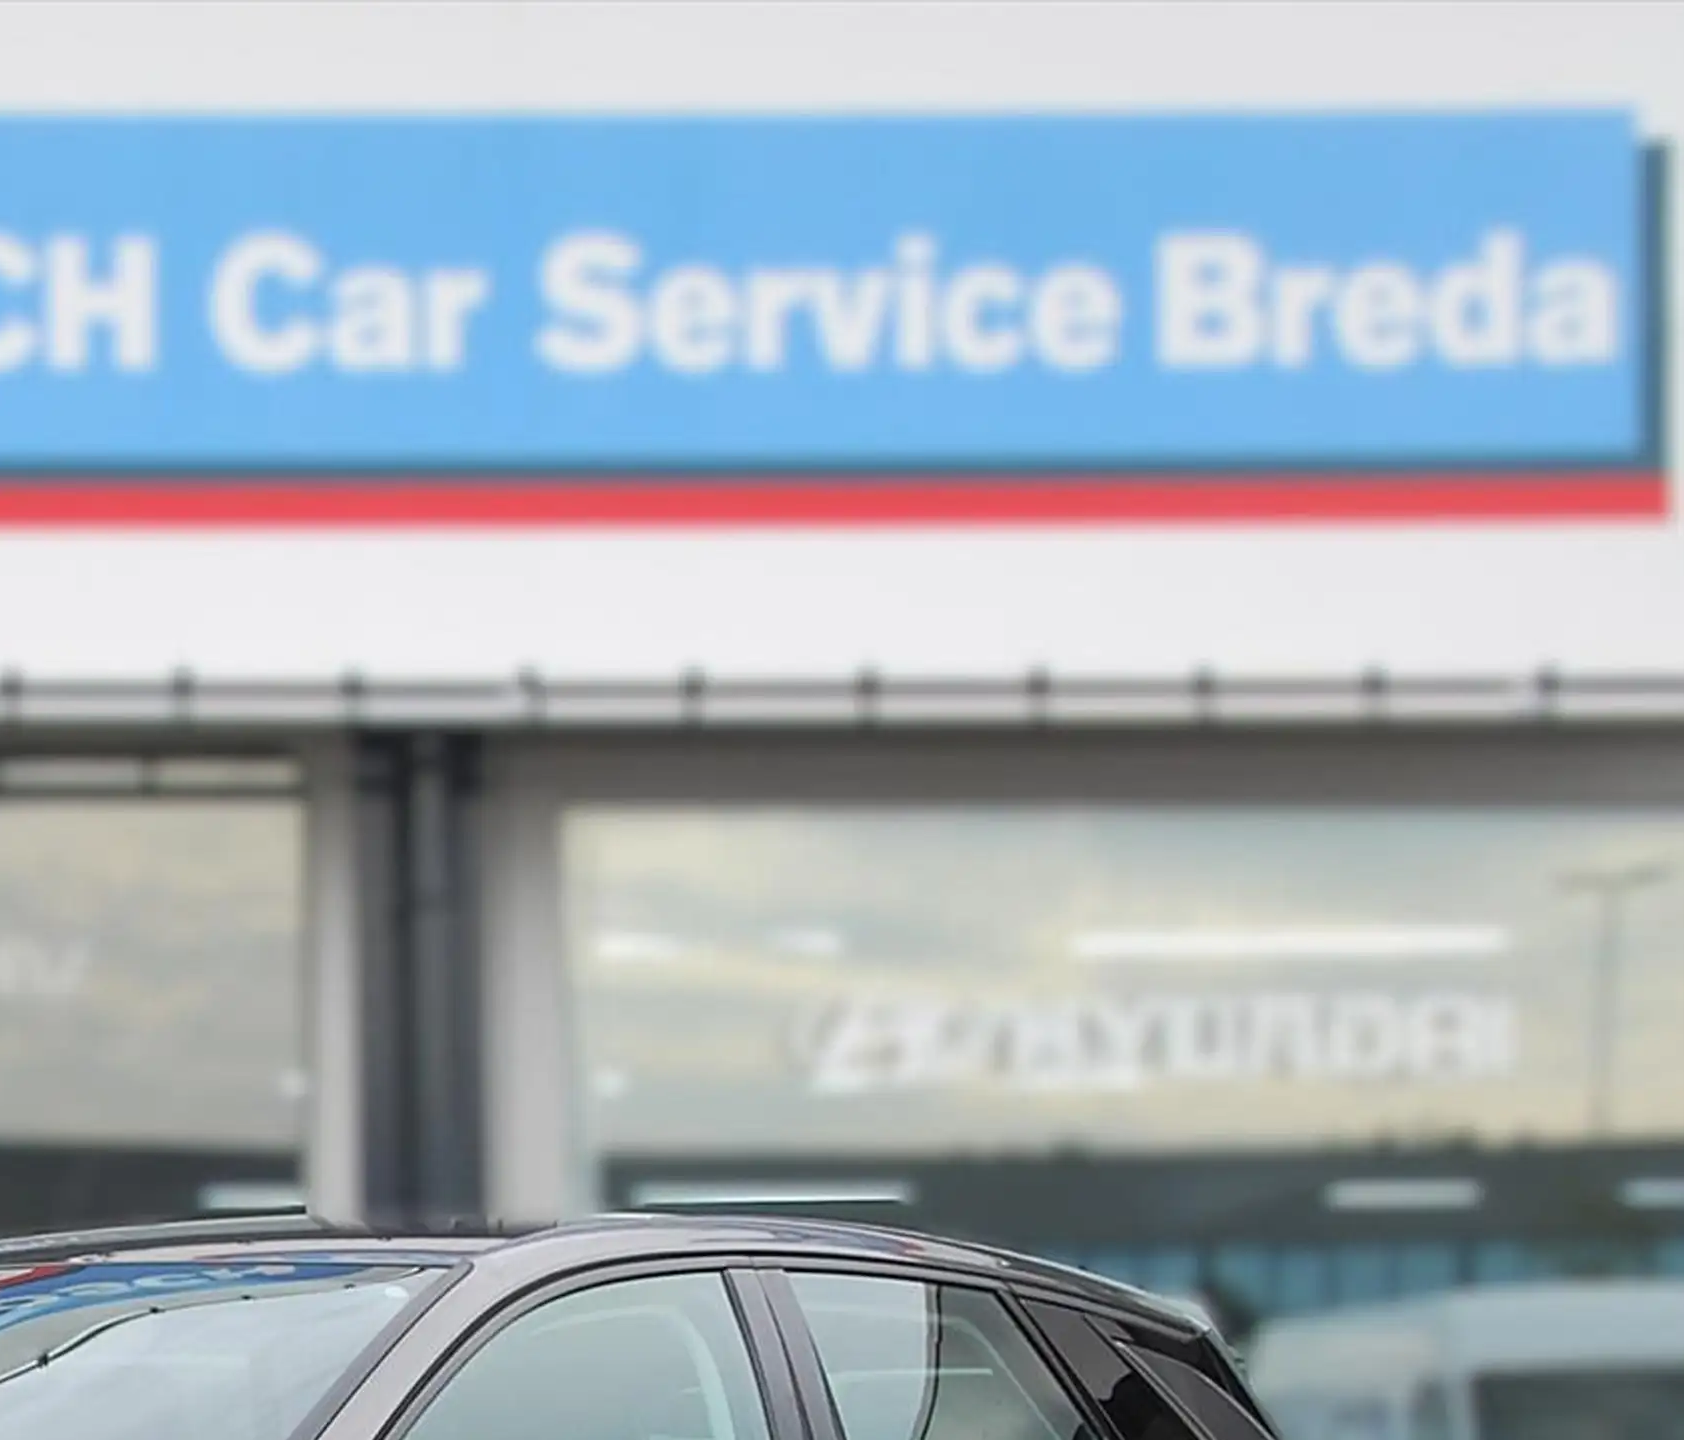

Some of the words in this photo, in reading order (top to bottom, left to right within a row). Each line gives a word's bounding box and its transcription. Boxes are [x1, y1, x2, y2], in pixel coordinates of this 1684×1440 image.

[210, 230, 489, 374] Car
[538, 230, 1121, 373] Service
[1155, 224, 1620, 369] Breda
